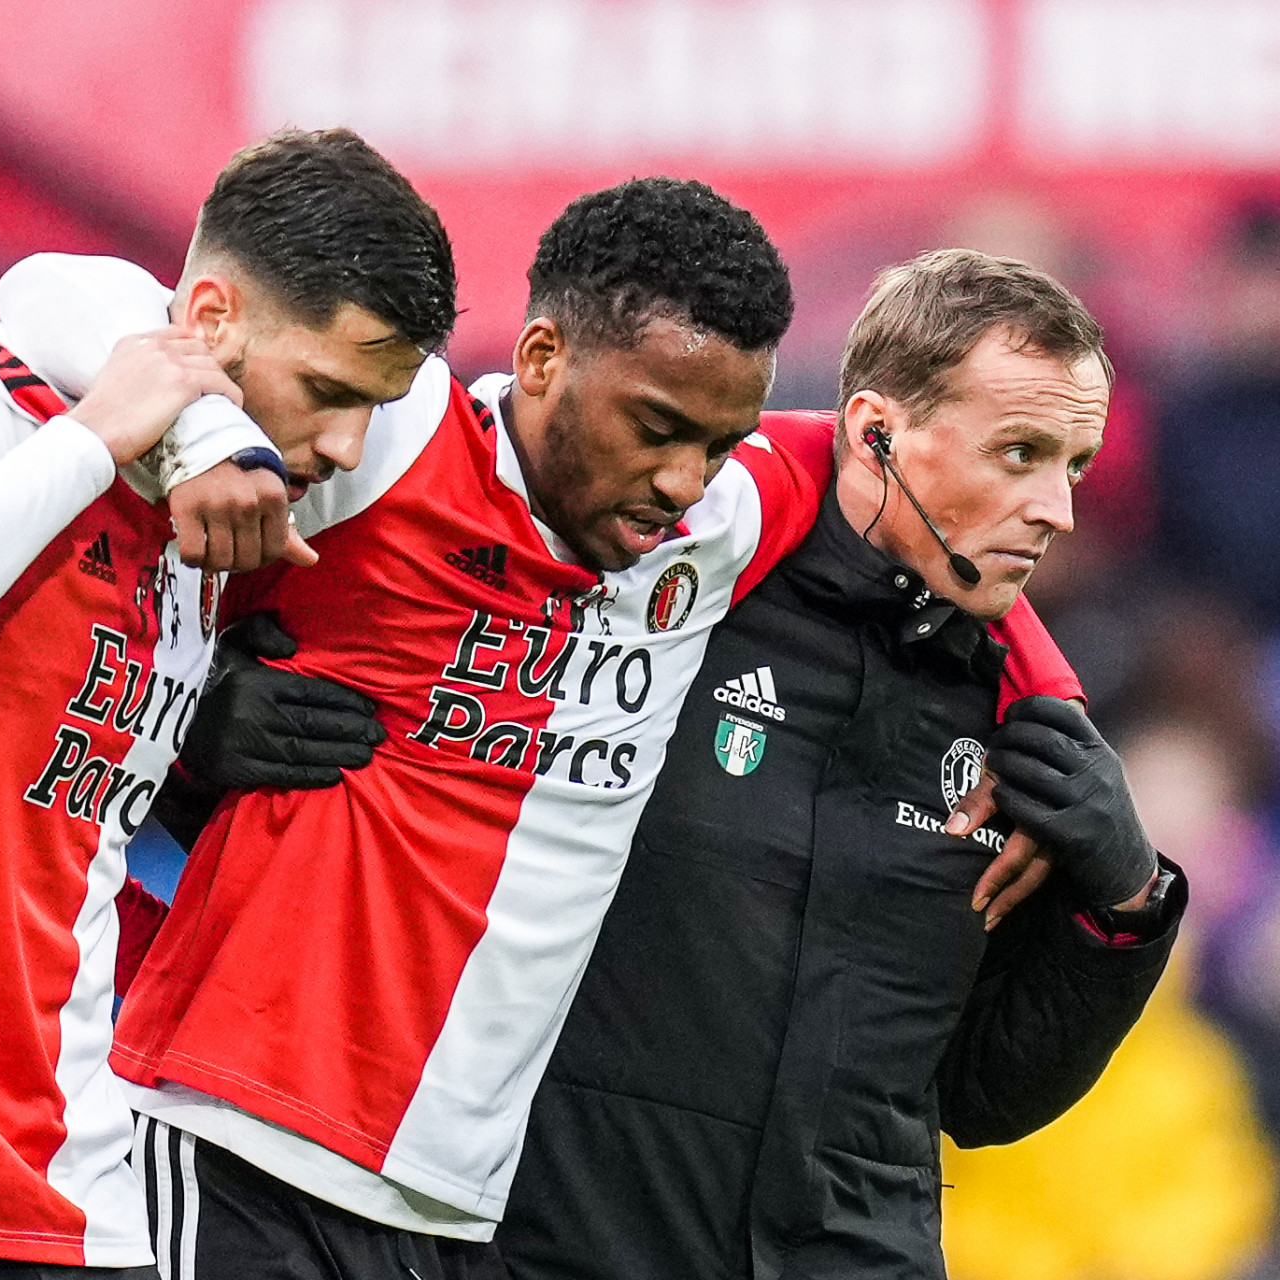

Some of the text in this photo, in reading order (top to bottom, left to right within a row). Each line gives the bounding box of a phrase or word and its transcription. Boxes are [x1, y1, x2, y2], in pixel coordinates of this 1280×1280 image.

[65, 623, 198, 754] Euro
[441, 610, 652, 714] Euro
[713, 686, 786, 721] adidas
[406, 686, 637, 788] Parcs
[895, 801, 1007, 853] Eurarc
